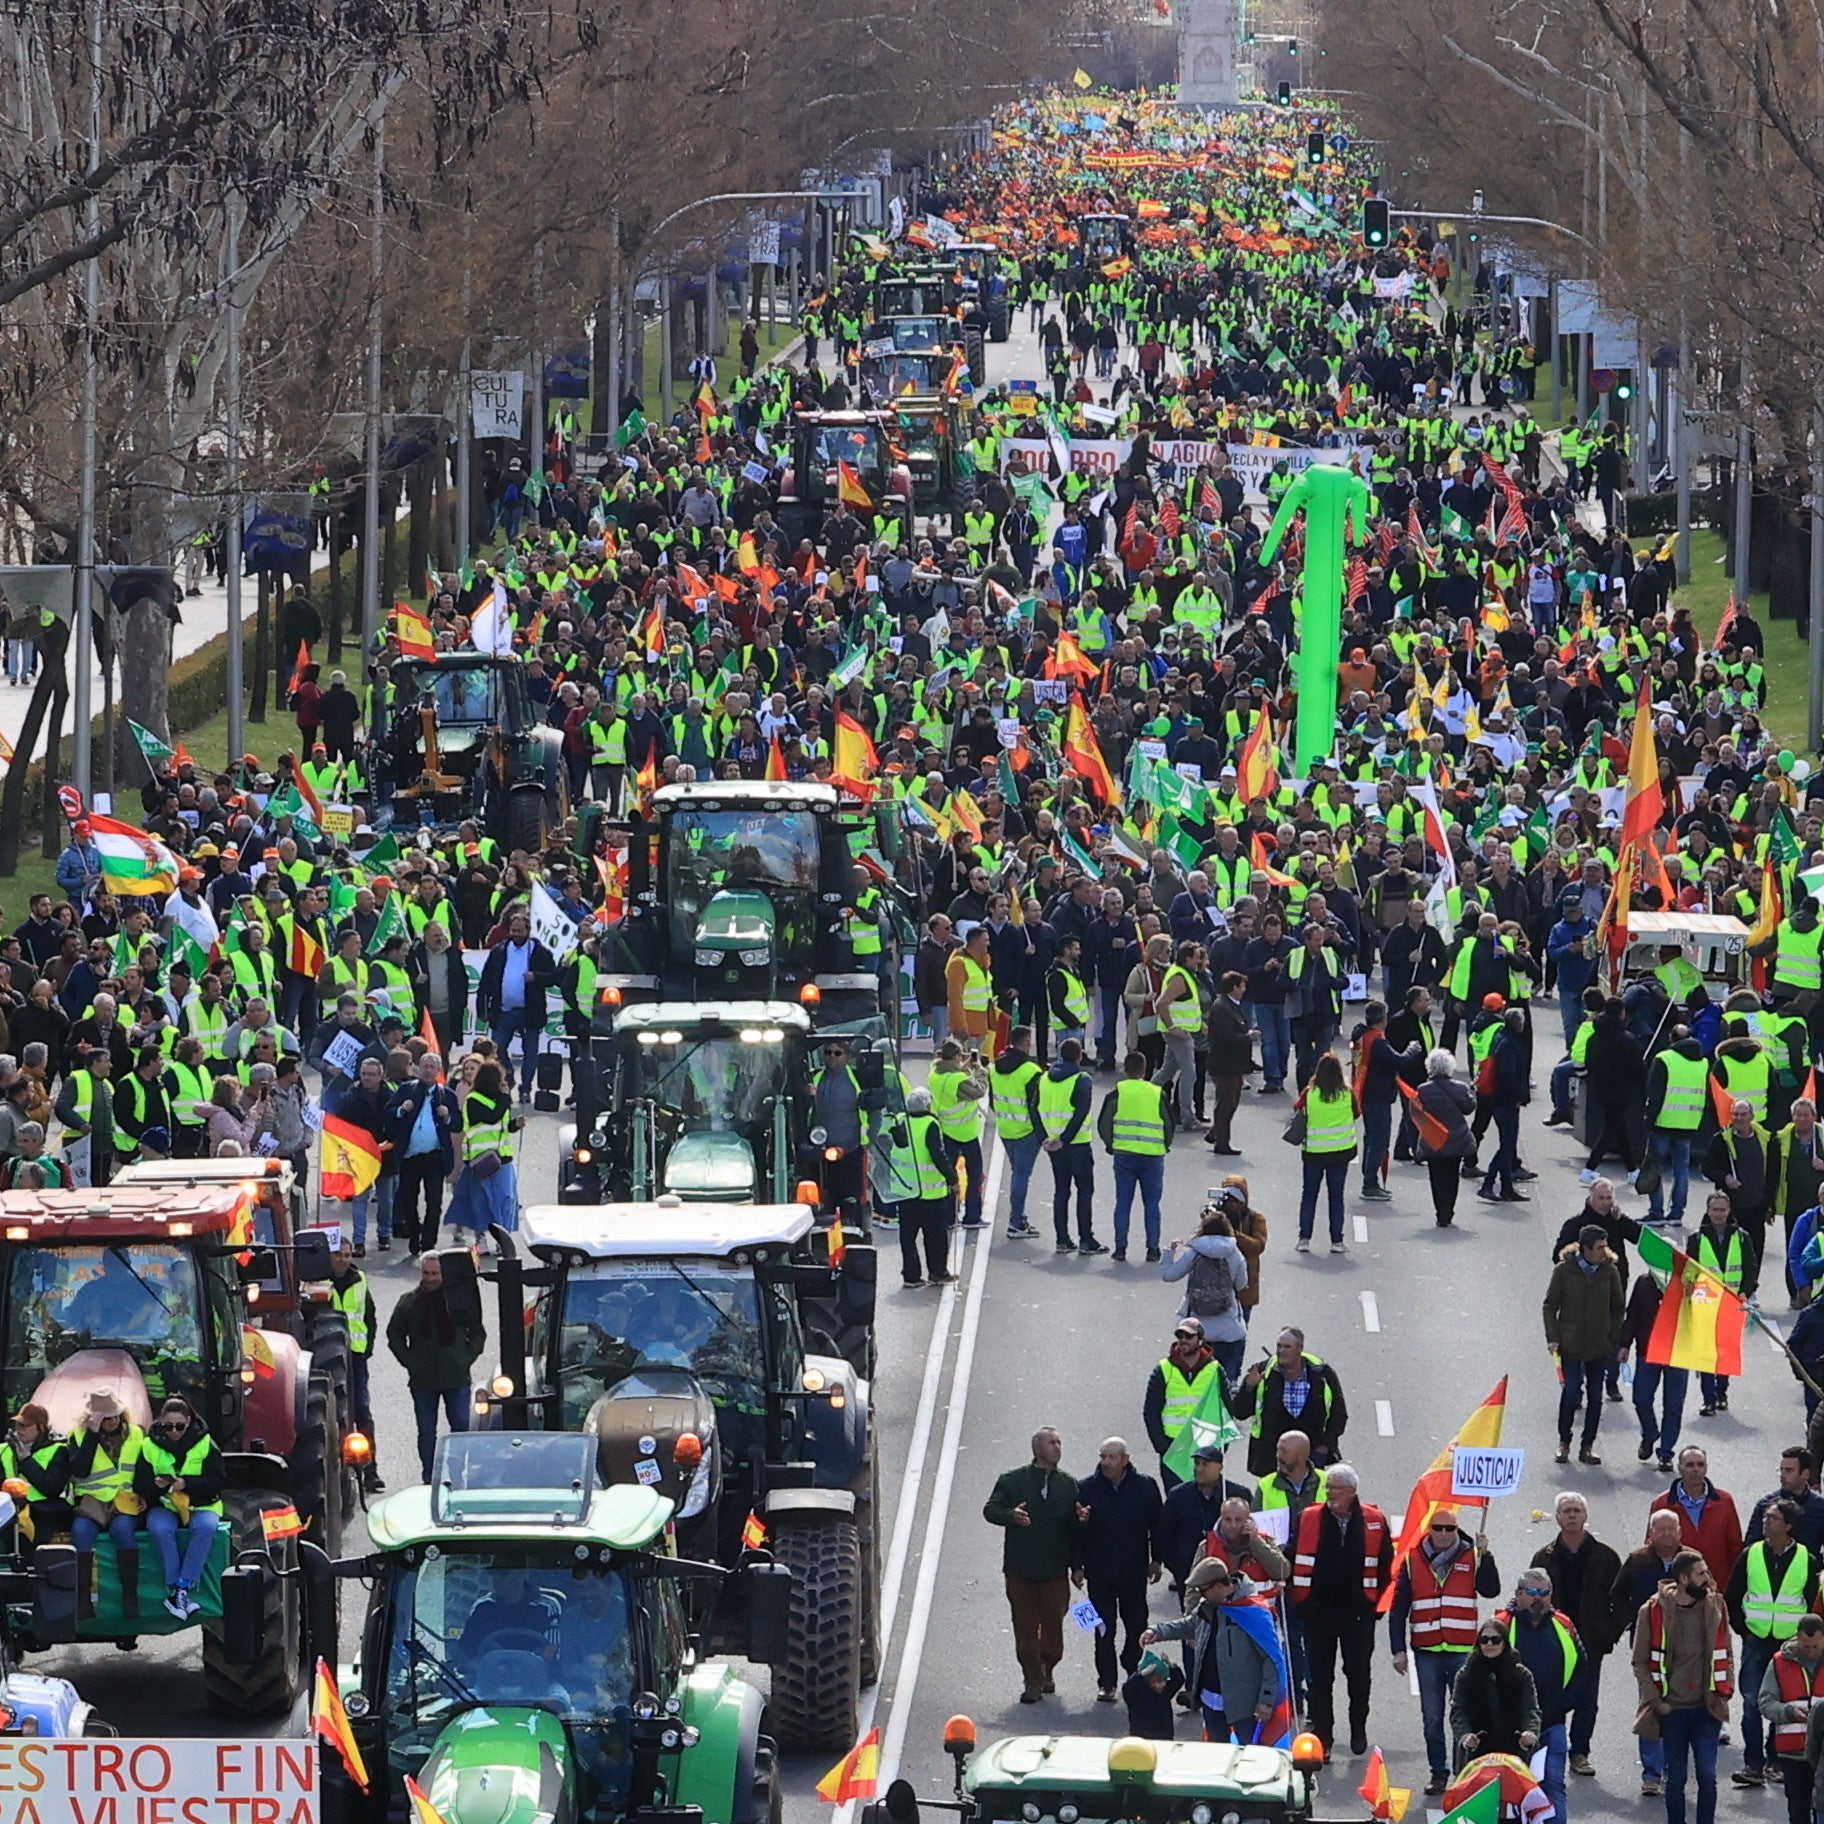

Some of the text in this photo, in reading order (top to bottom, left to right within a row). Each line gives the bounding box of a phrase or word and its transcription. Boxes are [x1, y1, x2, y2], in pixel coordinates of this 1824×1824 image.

[485, 393, 507, 407] TU
[496, 410, 518, 427] RA
[1728, 936, 1741, 951] 25
[1456, 1455, 1520, 1485] ¡JUSTICIA!
[216, 1745, 315, 1793] FIN
